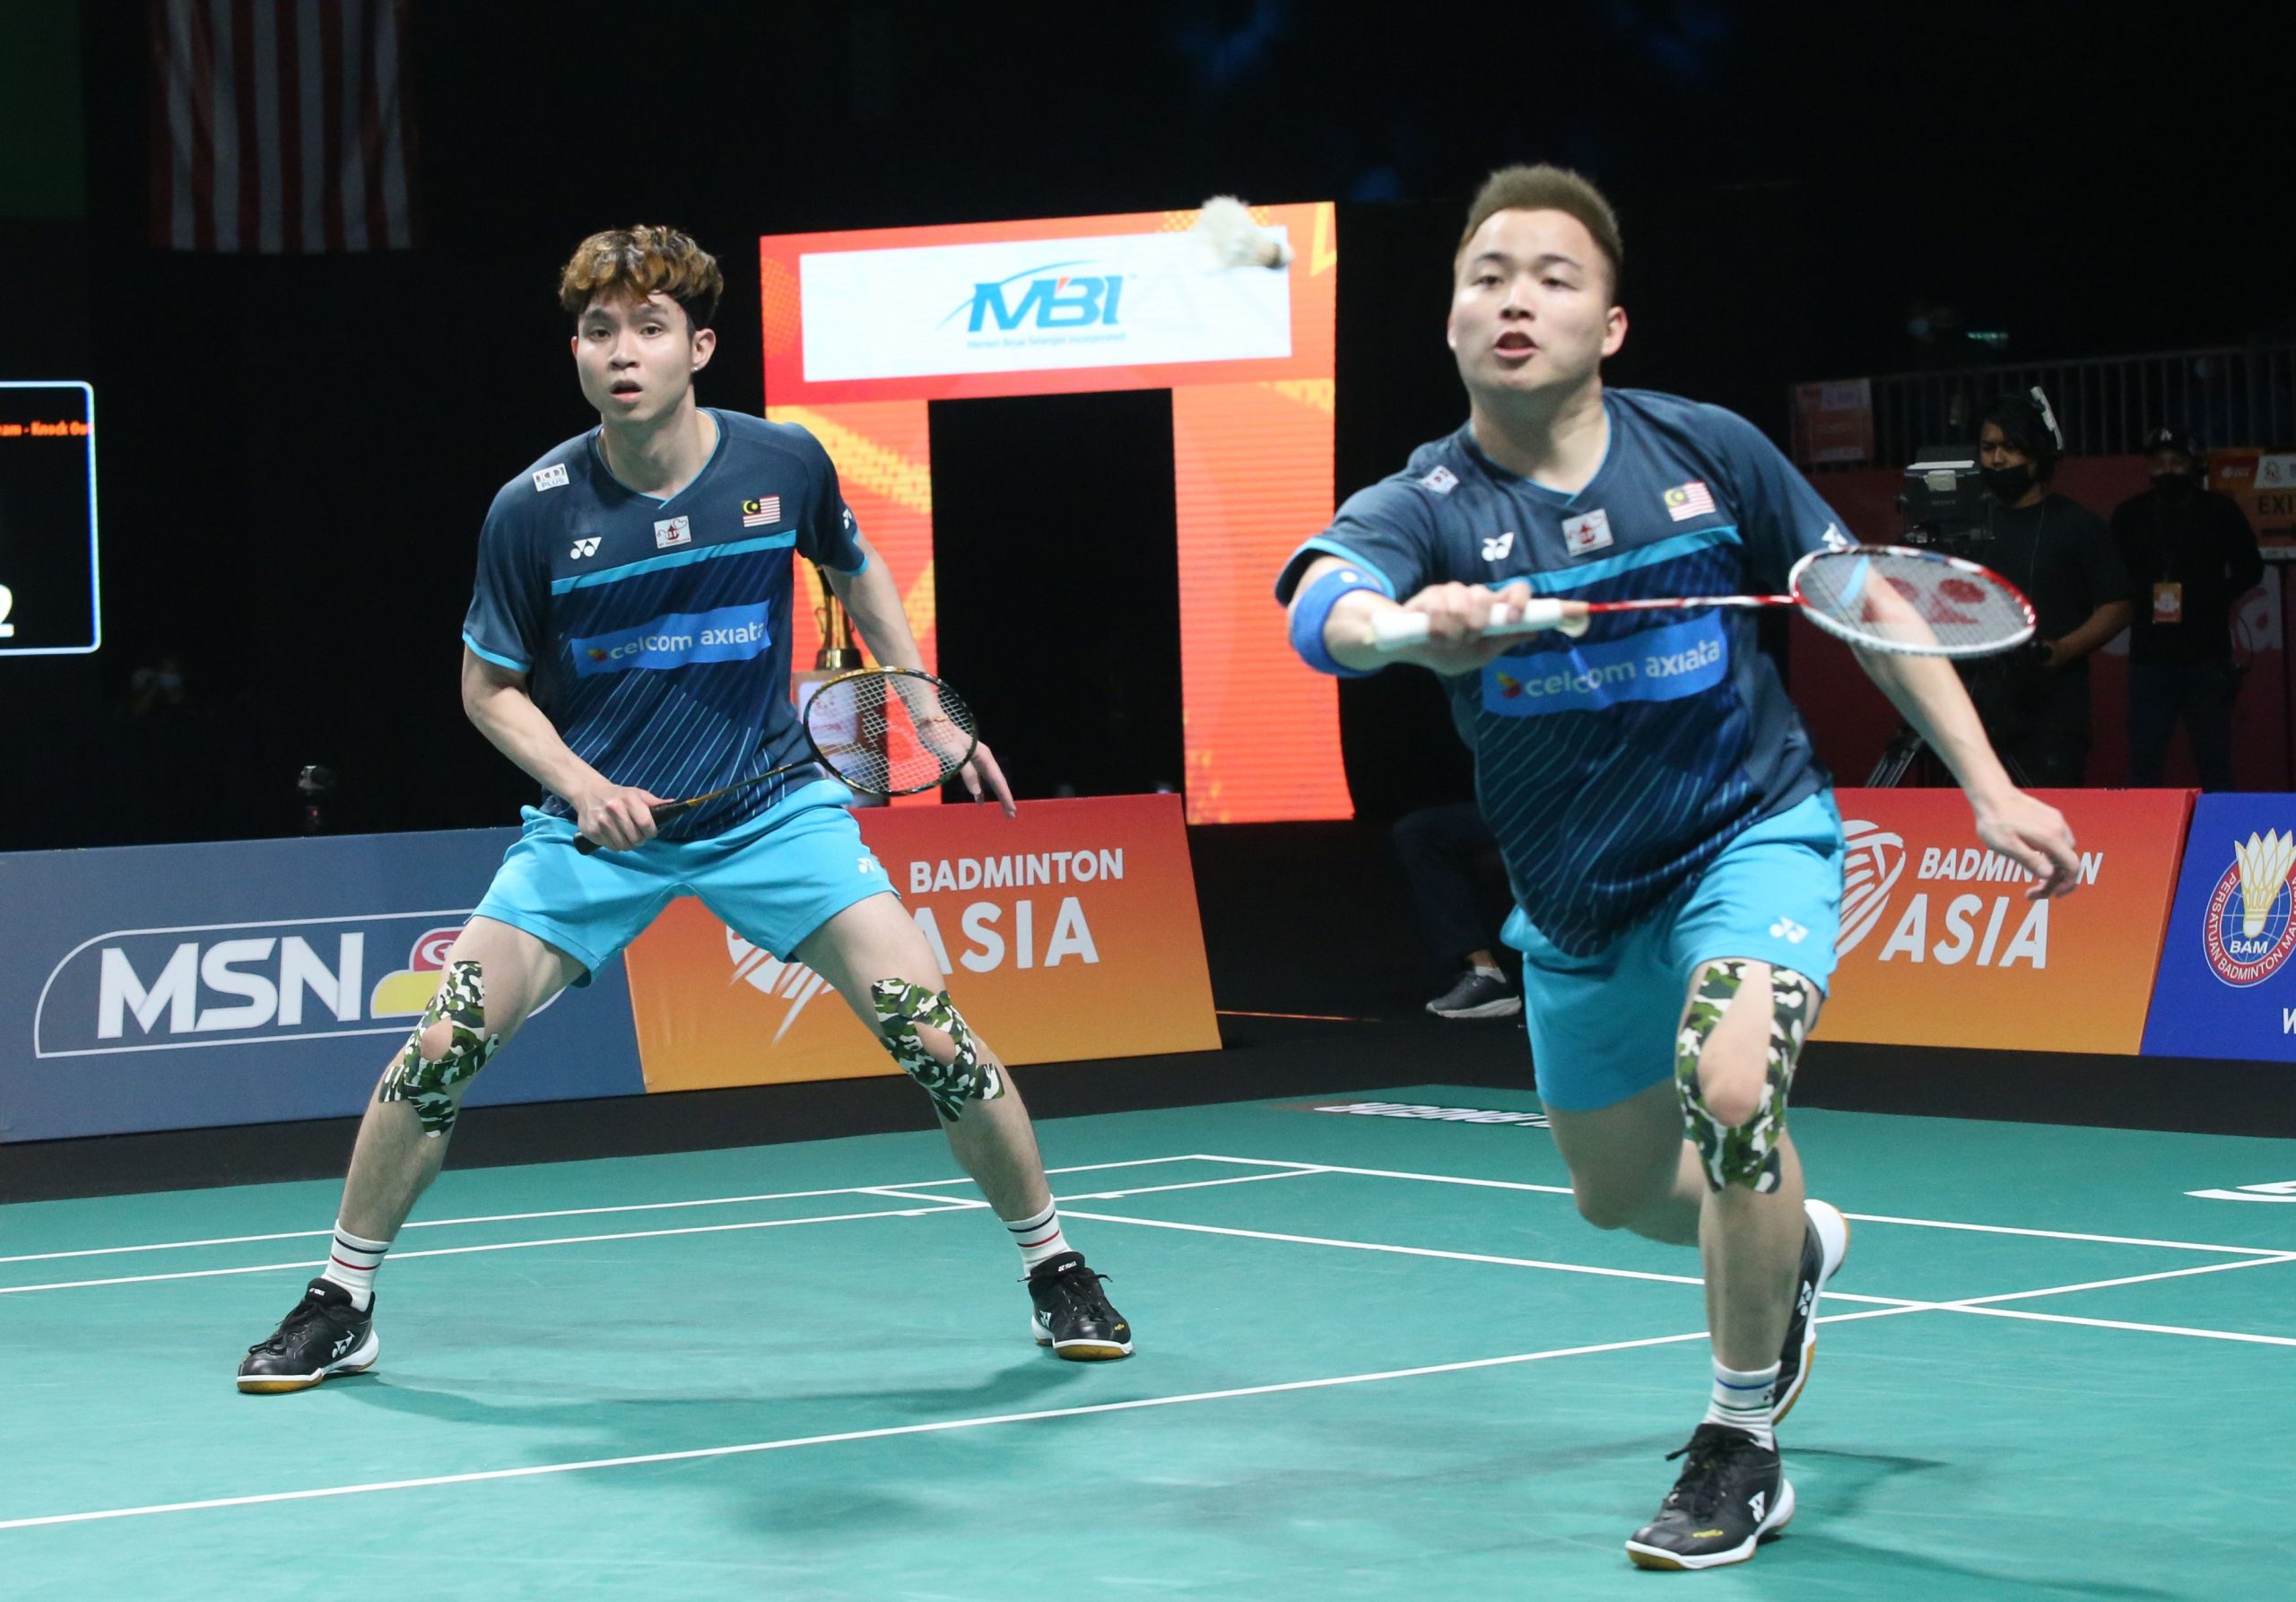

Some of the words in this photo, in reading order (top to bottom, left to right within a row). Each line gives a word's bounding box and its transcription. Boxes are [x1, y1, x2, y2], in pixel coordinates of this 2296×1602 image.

[967, 275, 1124, 333] MBI
[2258, 494, 2296, 516] EXI
[610, 635, 693, 660] celcom
[1526, 659, 1637, 698] celcom
[1645, 639, 1722, 679] axiata
[909, 848, 1124, 893] BADMINTON
[1917, 847, 2104, 885] BADMINN
[1878, 893, 2049, 970] ASIA
[2208, 872, 2237, 962] PERSATUAN
[2217, 948, 2283, 980] BADMINTON
[2230, 940, 2268, 954] BAM
[98, 932, 365, 1040] MSN
